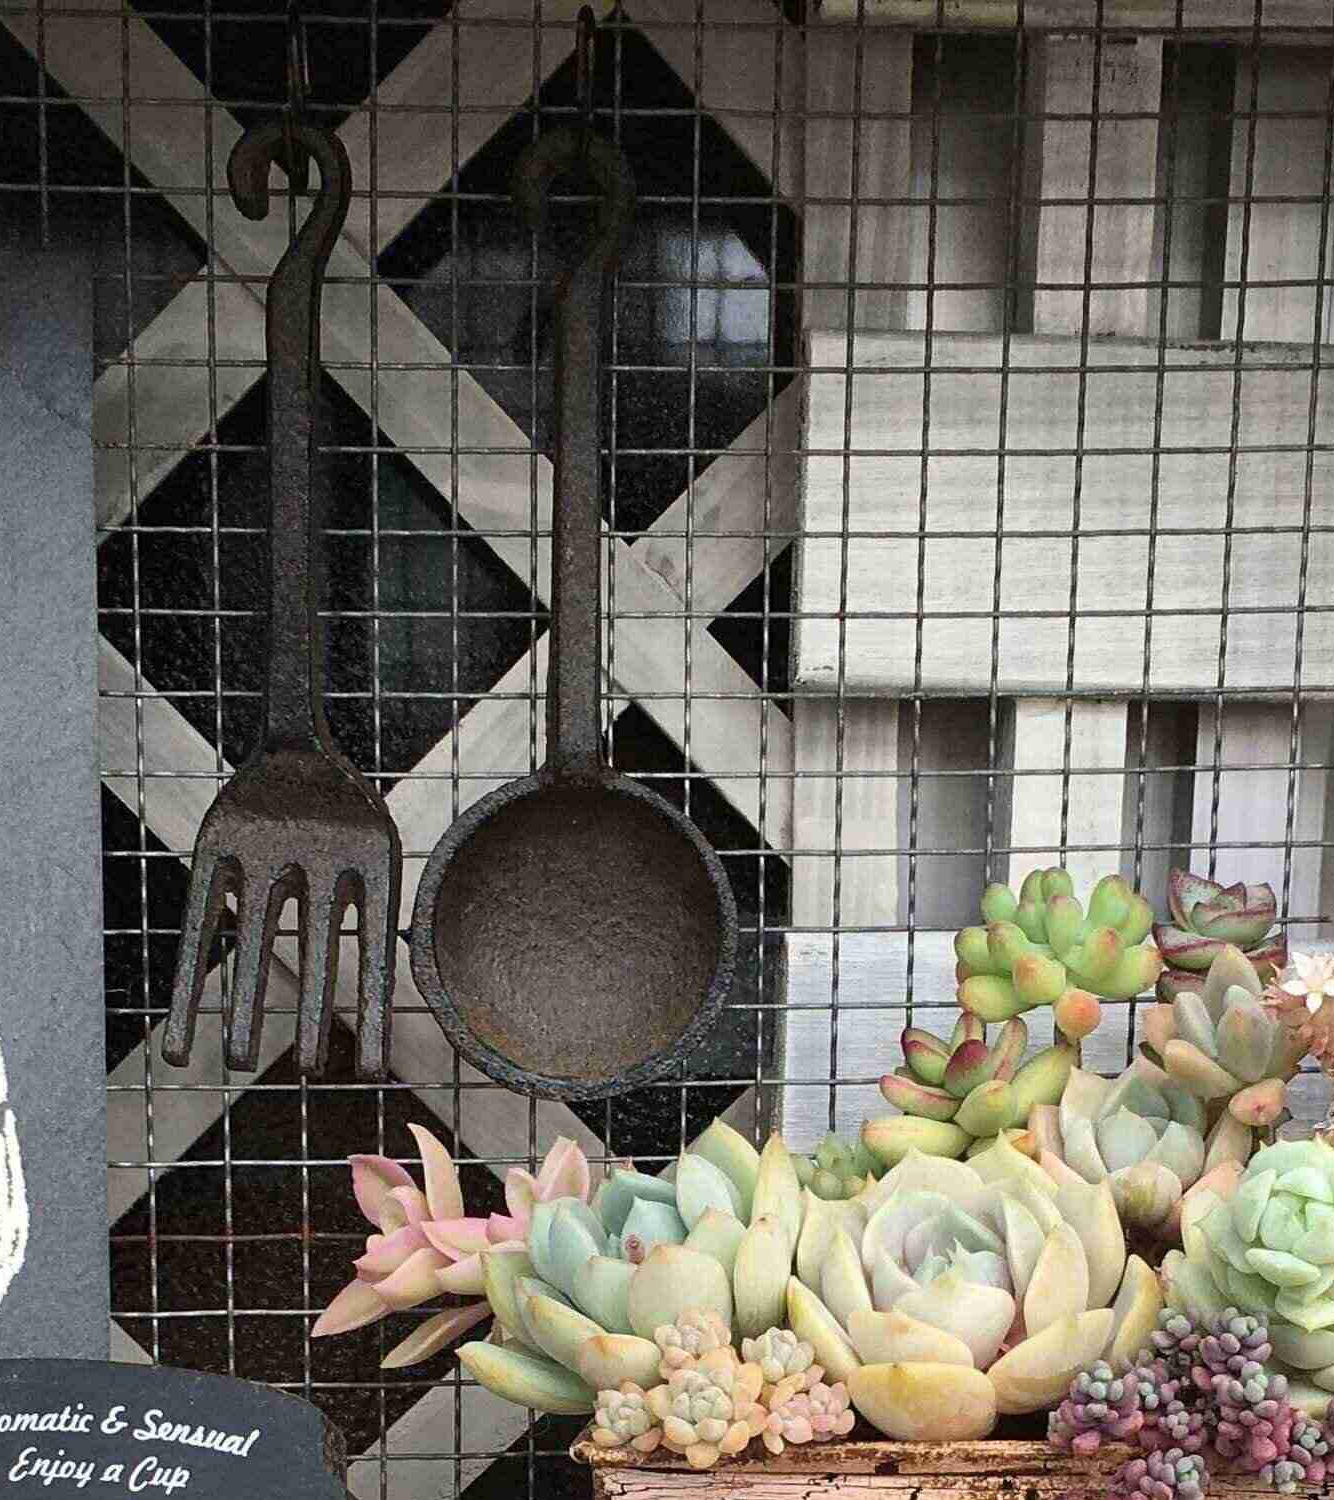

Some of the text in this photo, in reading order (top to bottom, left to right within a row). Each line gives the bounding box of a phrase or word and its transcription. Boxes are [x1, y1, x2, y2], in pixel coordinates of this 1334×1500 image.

[100, 1405, 128, 1435] &
[133, 1408, 261, 1459] Sensual
[8, 1446, 193, 1496] Enjoy a Cup
